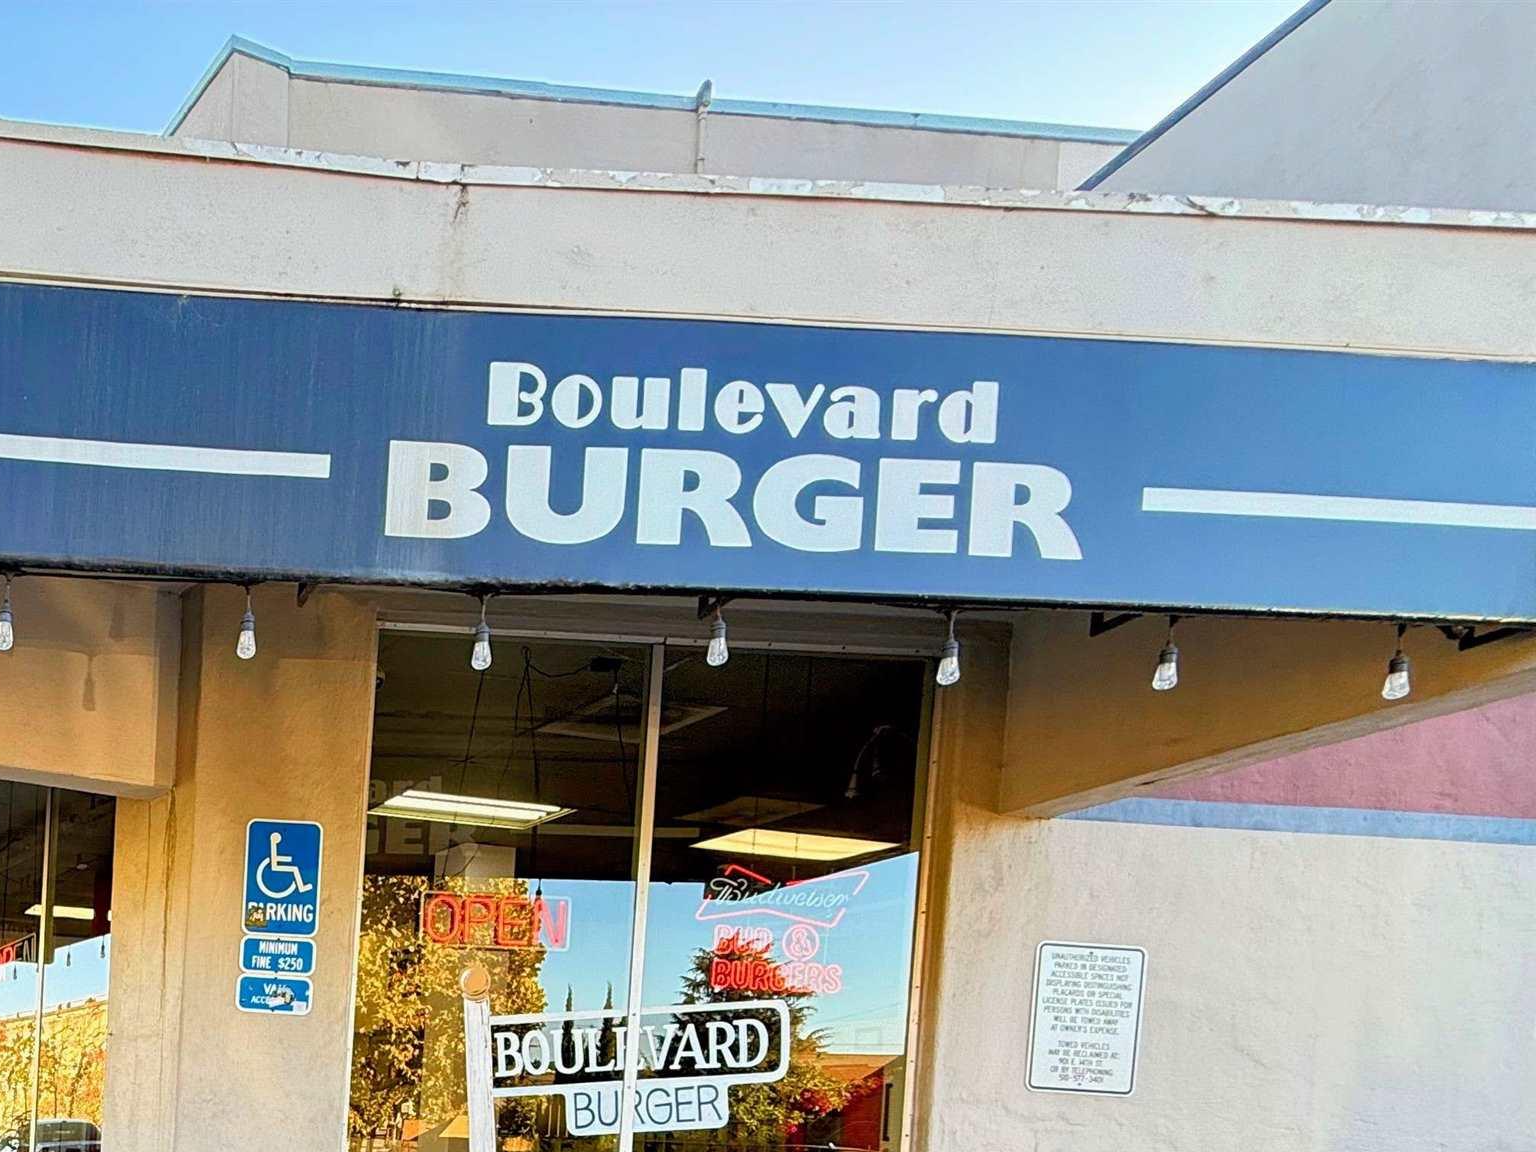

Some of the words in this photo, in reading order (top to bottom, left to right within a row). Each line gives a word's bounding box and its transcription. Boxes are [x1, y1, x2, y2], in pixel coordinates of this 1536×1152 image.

[486, 361, 1000, 444] Boulevard
[384, 440, 1085, 561] BURGER
[709, 877, 848, 909] Budweiser
[248, 901, 314, 923] RKING
[423, 893, 568, 948] OPEN
[259, 940, 299, 955] MINIMUM
[713, 924, 774, 955] BUD
[251, 955, 272, 969] FINE
[277, 956, 304, 971] $250
[710, 958, 843, 994] BURGERS
